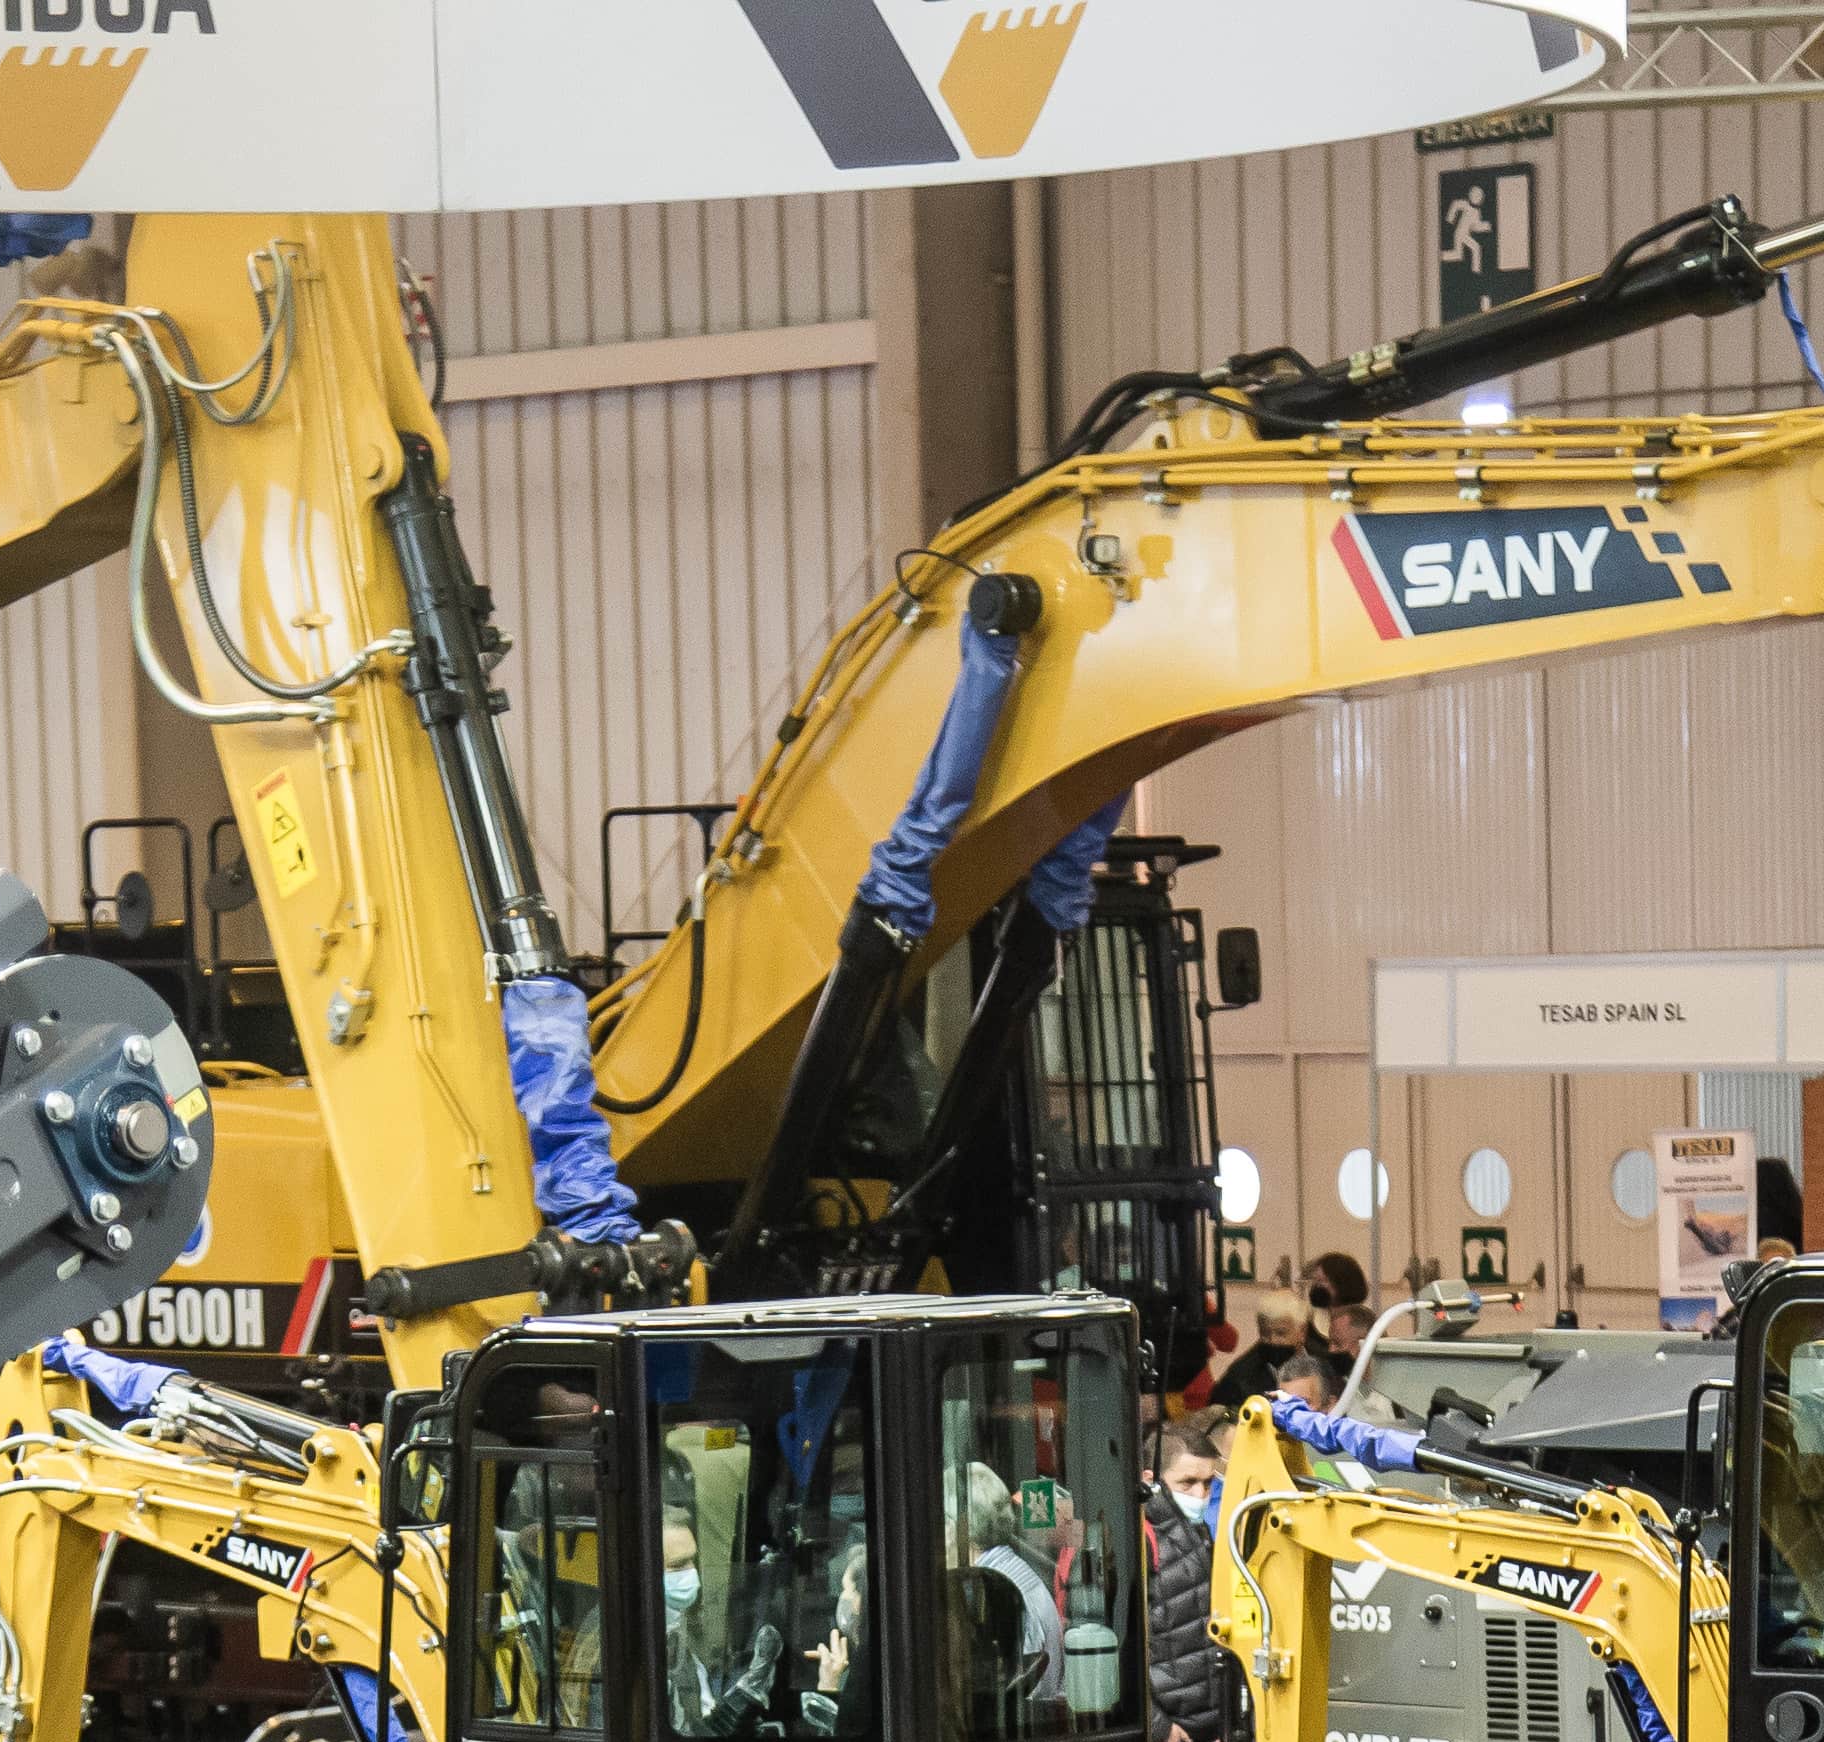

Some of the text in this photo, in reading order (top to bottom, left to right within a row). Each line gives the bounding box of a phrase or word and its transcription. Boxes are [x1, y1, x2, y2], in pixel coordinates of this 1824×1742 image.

[1401, 526, 1610, 609] SANY
[1539, 1002, 1687, 1023] TESAB SPAIN SL
[92, 1286, 266, 1348] SY500H
[226, 1536, 296, 1580] SANY
[1497, 1561, 1581, 1602] SANY
